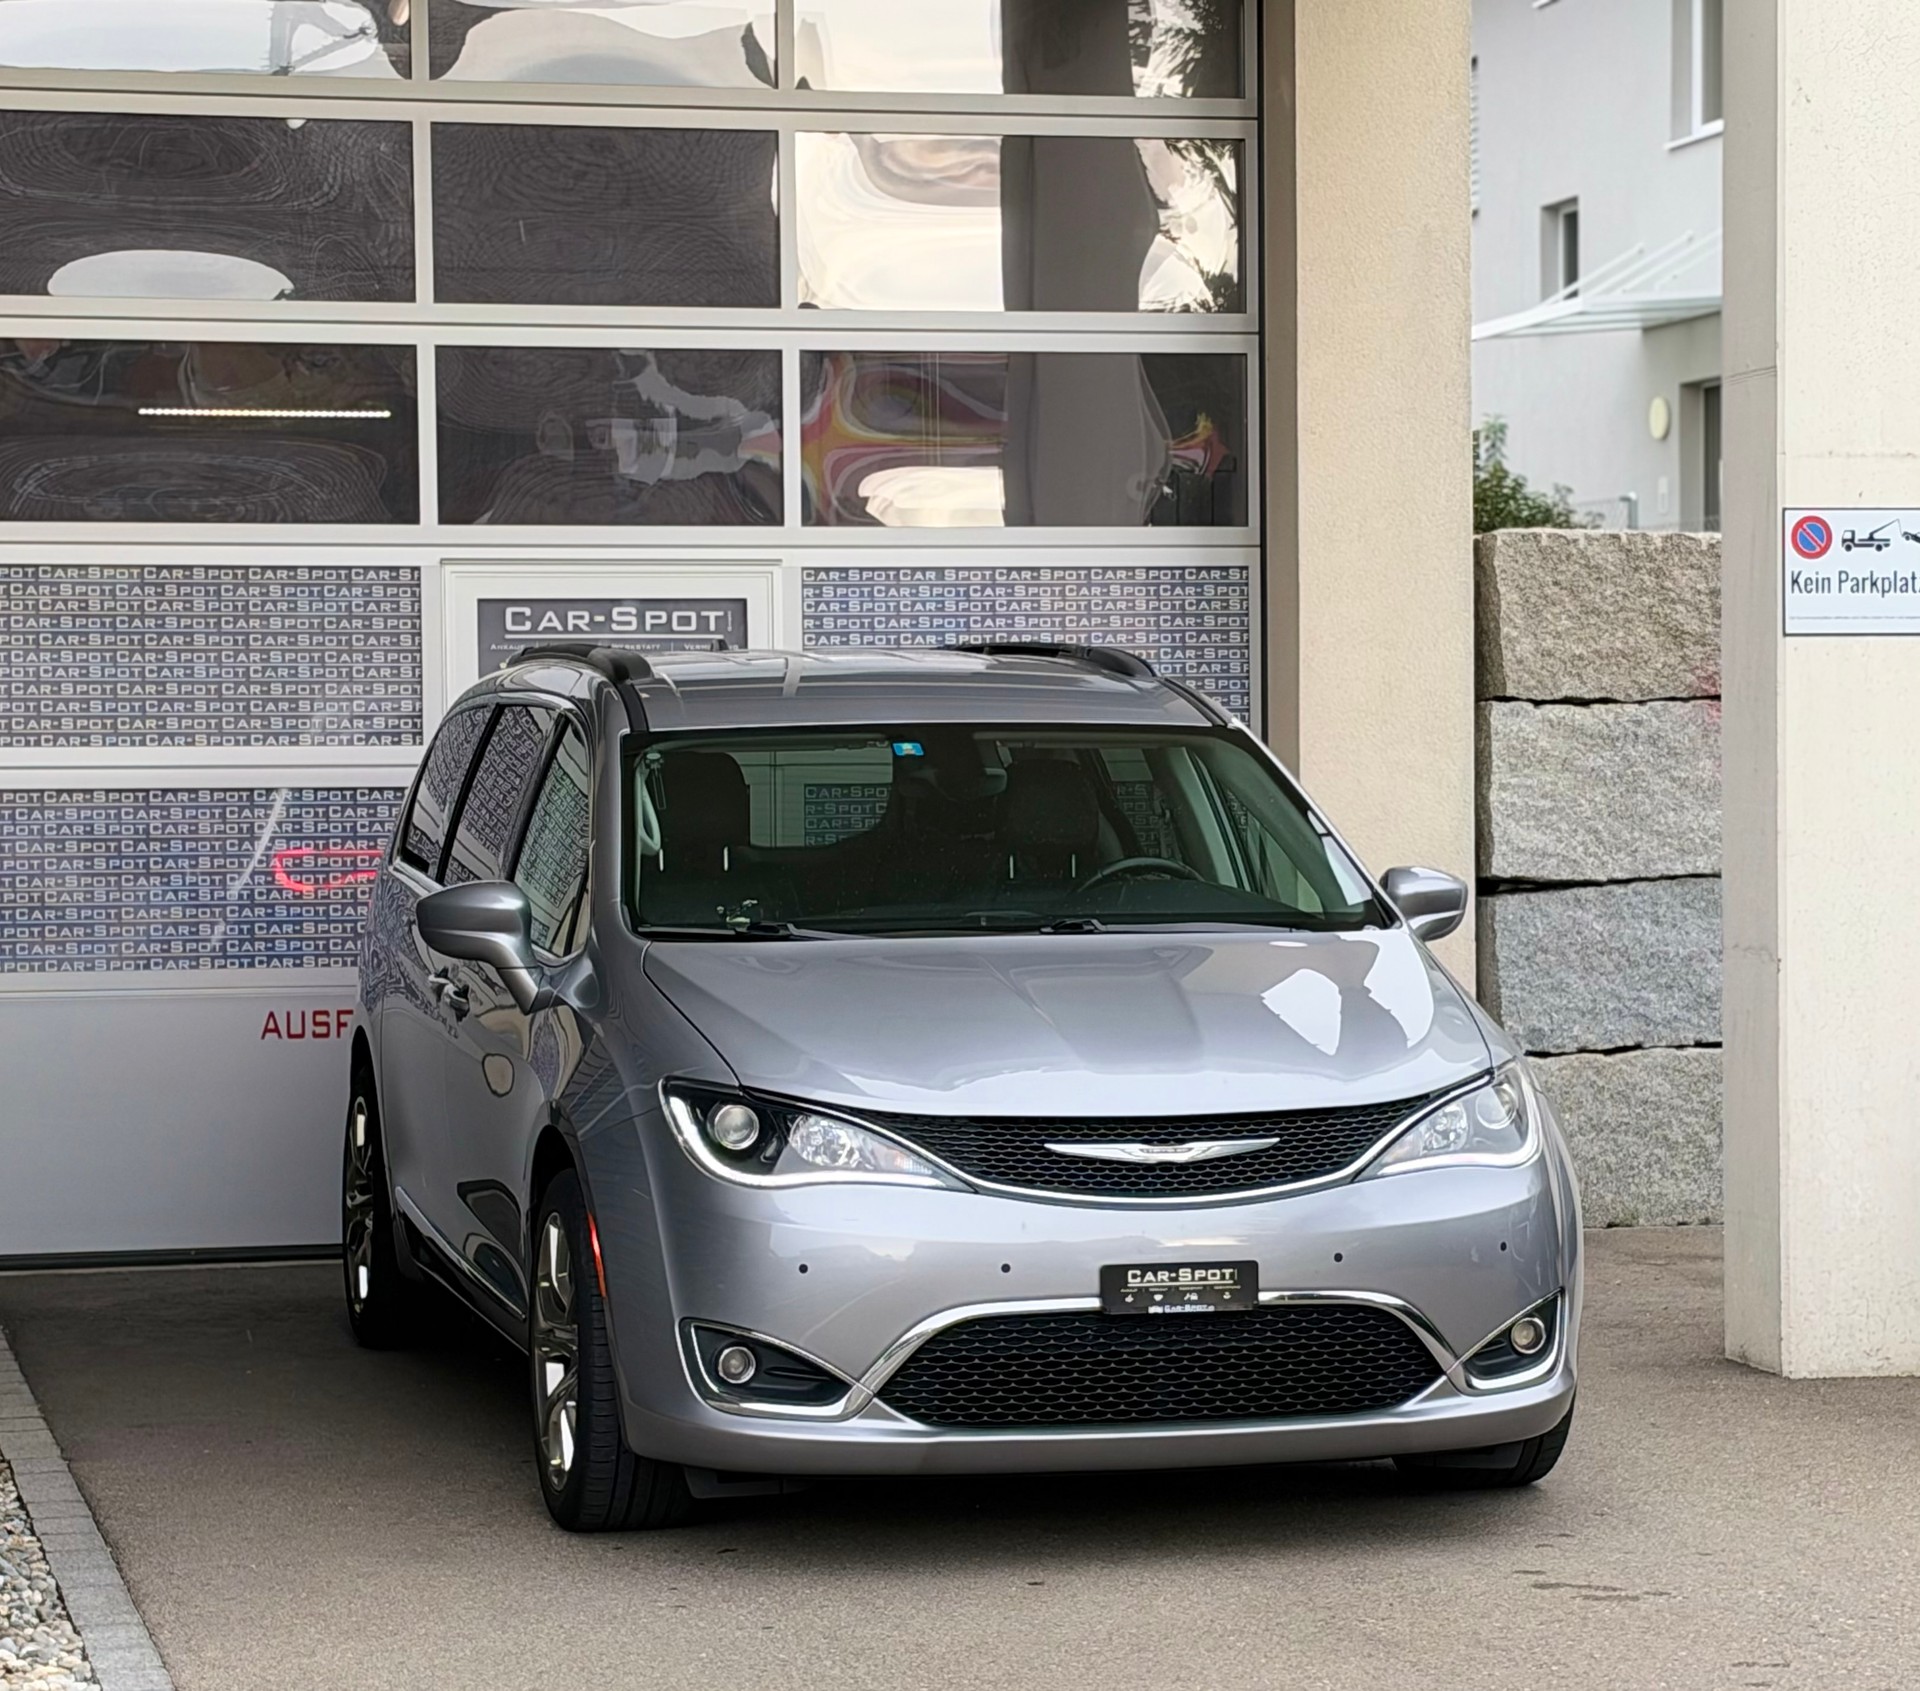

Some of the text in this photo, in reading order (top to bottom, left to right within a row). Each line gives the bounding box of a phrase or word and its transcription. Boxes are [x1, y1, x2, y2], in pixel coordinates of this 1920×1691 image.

[1791, 570, 1831, 594] Kein
[505, 606, 724, 631] CAR-SPOT
[261, 1009, 354, 1040] AUSF
[1127, 1268, 1234, 1283] CAR-SPOT
